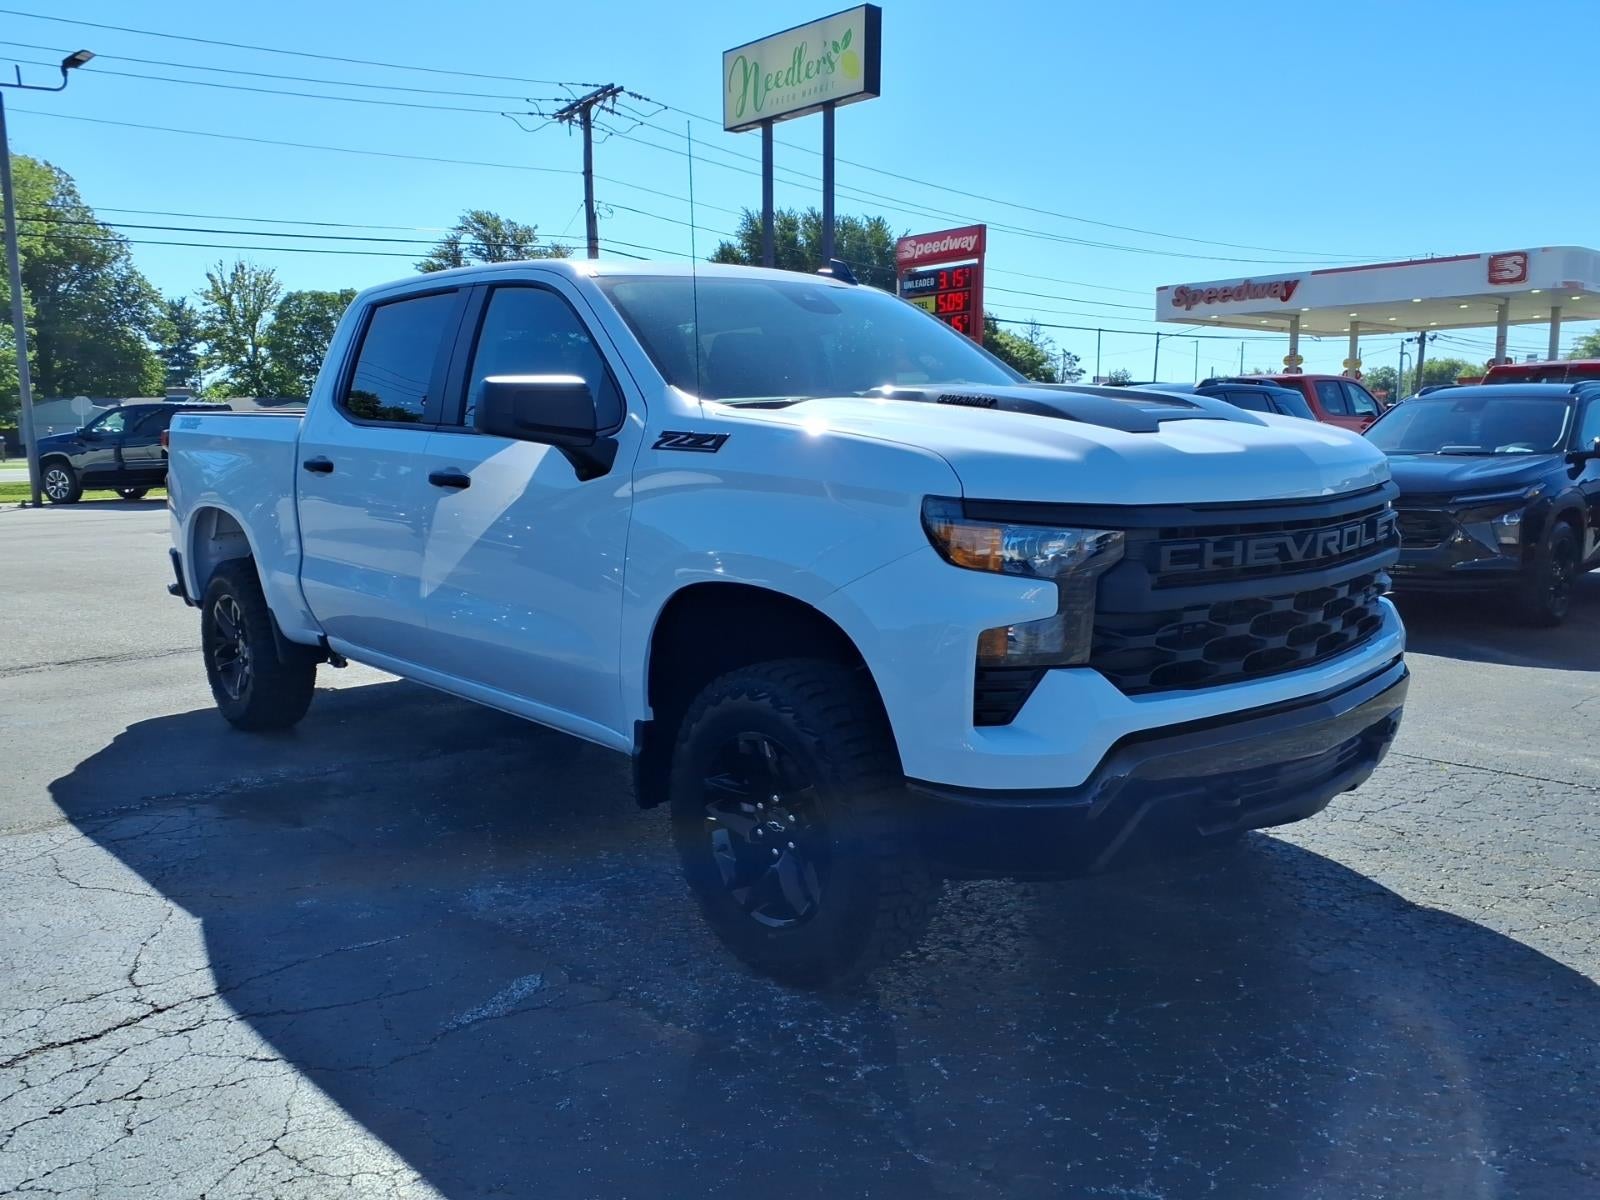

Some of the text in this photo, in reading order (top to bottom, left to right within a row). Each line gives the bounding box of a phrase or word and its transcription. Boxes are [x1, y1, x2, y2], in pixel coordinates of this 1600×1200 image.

[729, 41, 840, 118] Needler's
[900, 235, 977, 258] Speedway
[904, 278, 934, 289] UNLEADED
[1172, 279, 1300, 311] Speedway
